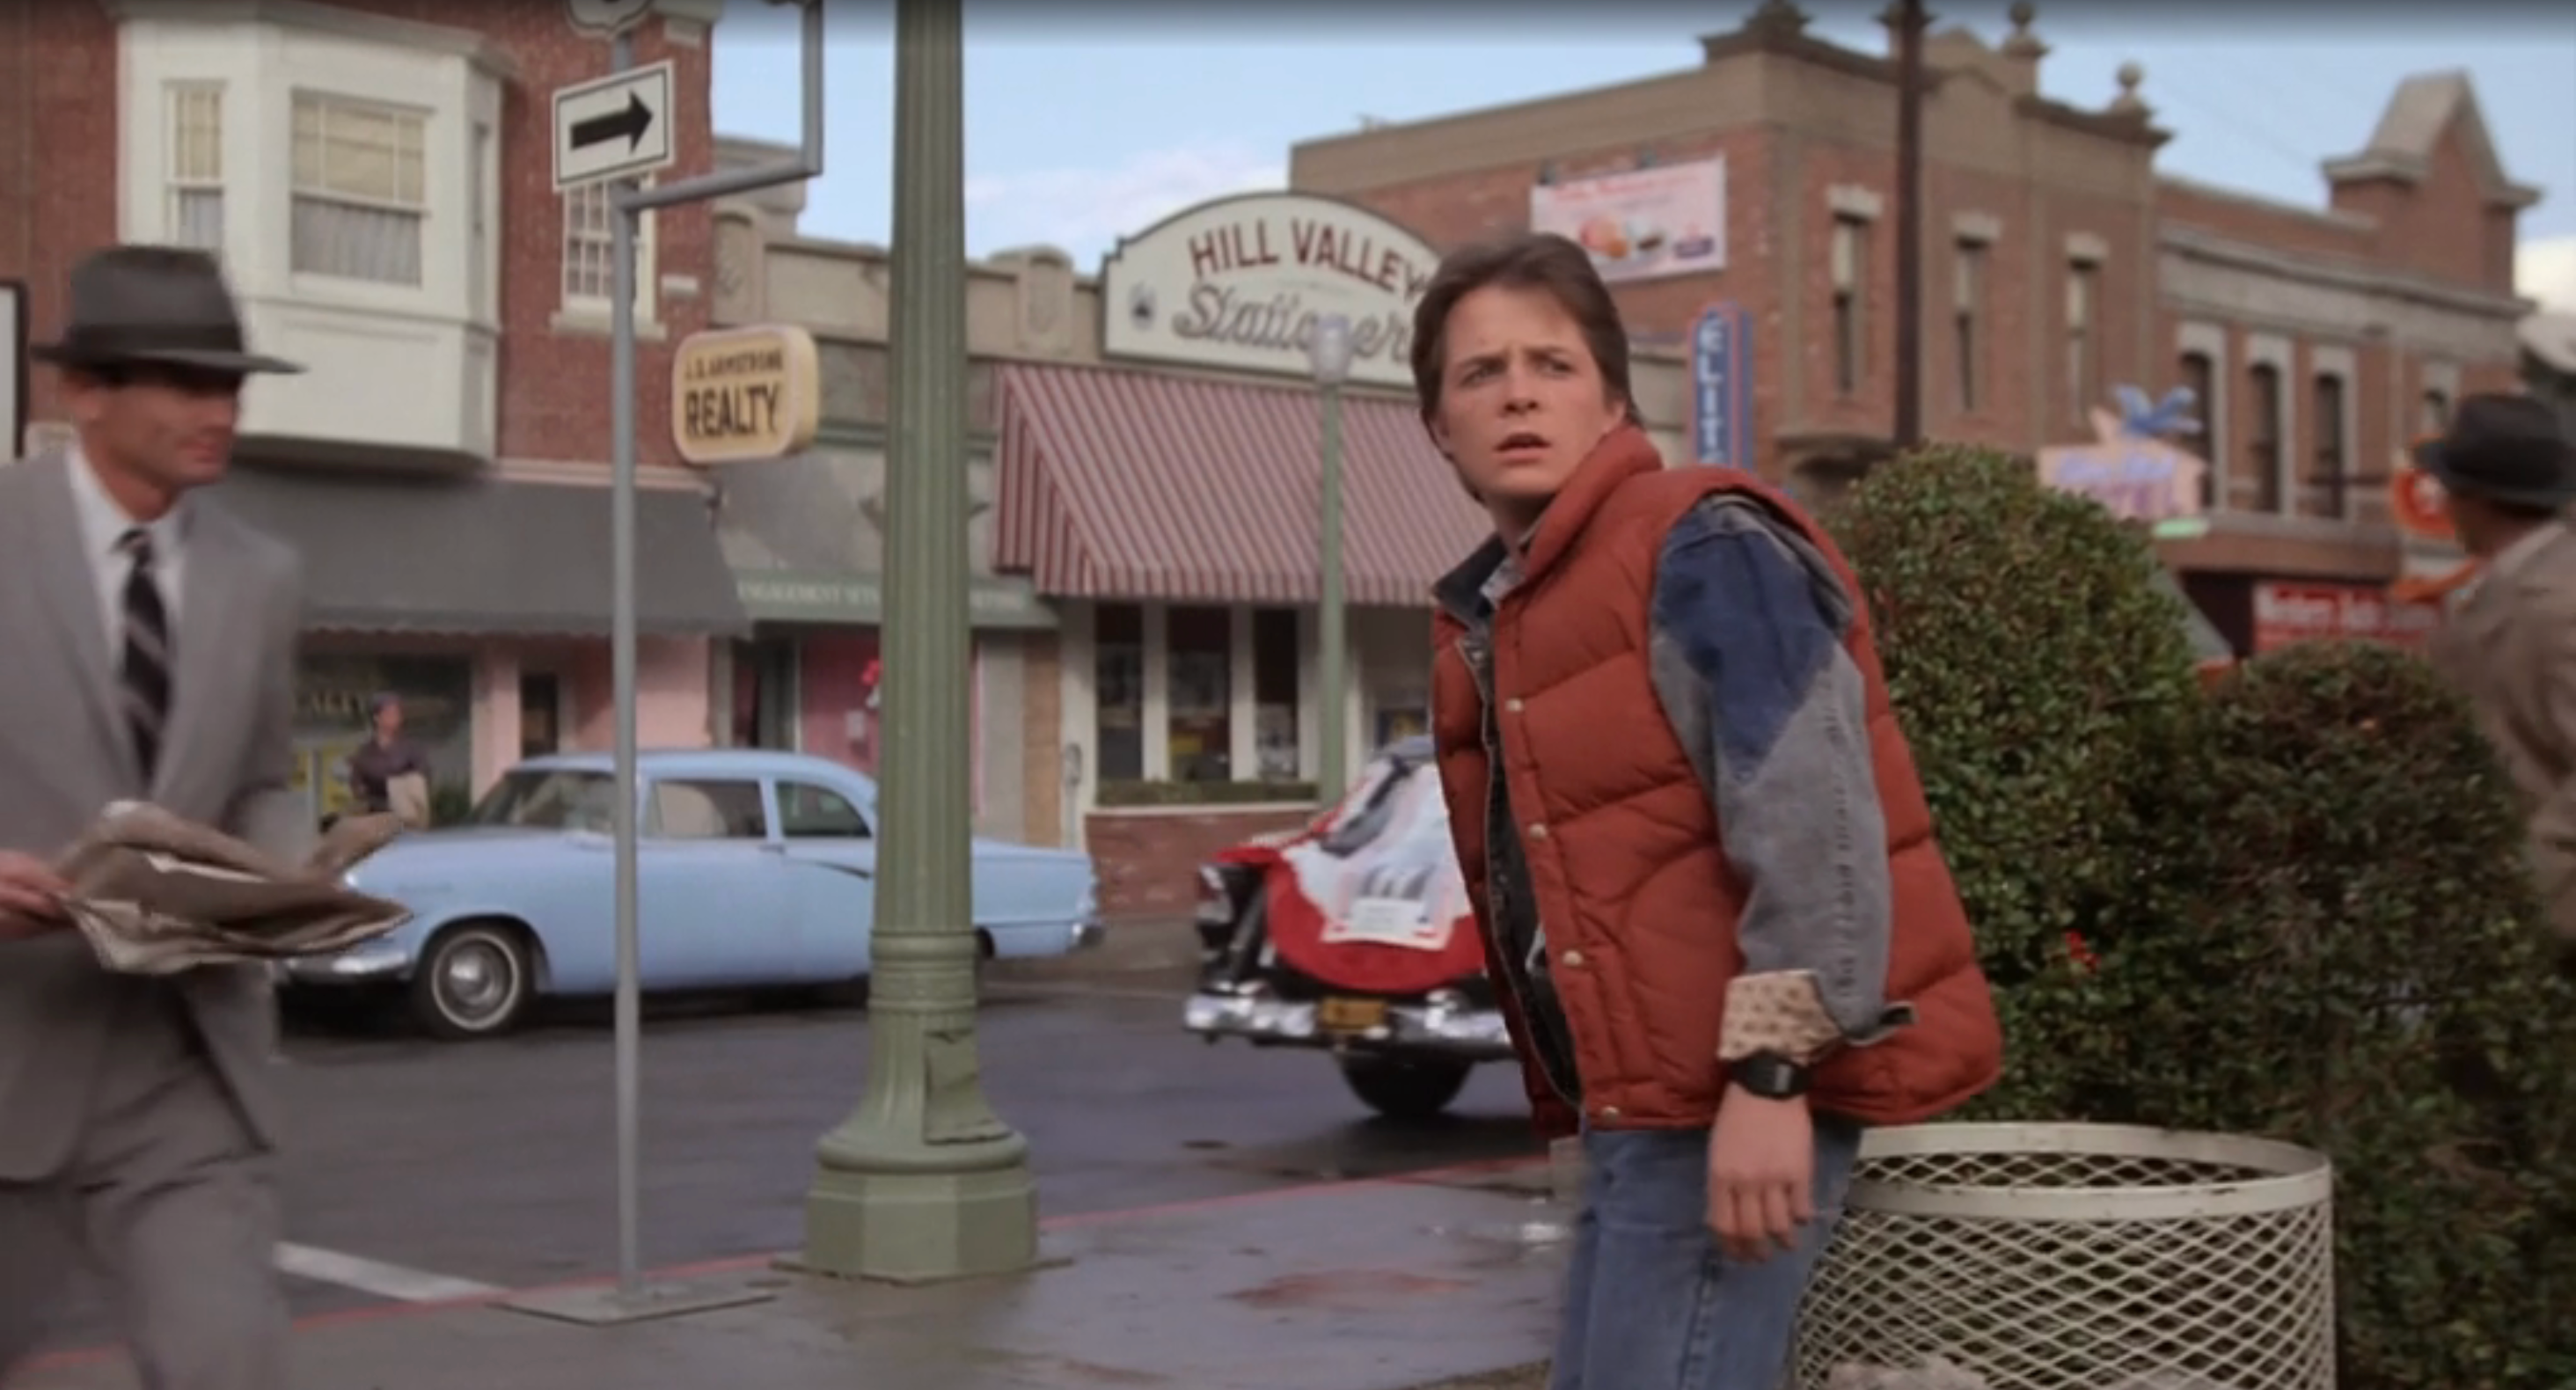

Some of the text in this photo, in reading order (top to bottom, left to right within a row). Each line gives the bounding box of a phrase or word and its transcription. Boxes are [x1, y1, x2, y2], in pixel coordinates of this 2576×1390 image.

[1189, 217, 1430, 304] HILL VALLEY
[1172, 282, 1413, 363] Statioer
[684, 380, 780, 438] REALTY
